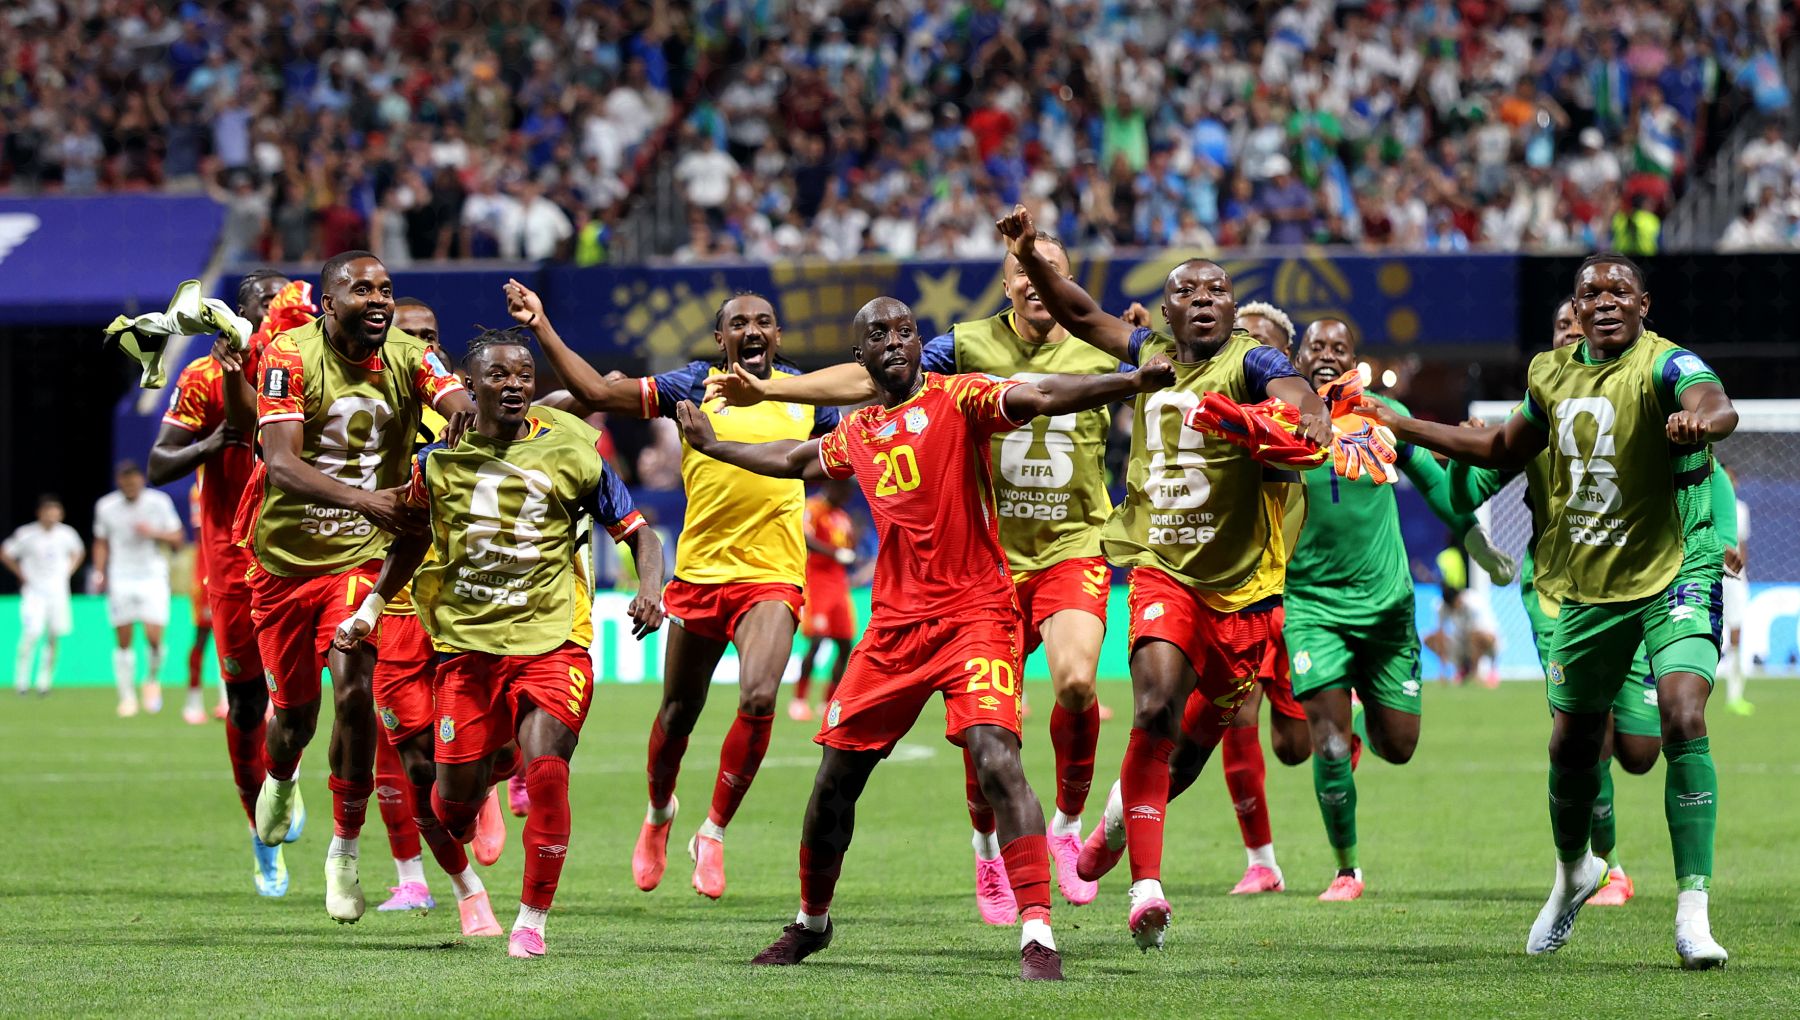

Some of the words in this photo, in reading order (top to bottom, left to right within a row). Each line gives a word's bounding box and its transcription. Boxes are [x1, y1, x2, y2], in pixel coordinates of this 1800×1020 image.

[873, 445, 921, 498] 20
[1021, 465, 1053, 478] FIFA
[1000, 489, 1044, 502] WORLD
[1046, 492, 1071, 503] CUP
[1160, 484, 1192, 498] FIFA
[1576, 489, 1606, 504] FIFA
[305, 504, 353, 519] WORLD
[1000, 501, 1068, 520] 2026
[1150, 513, 1185, 525] WORLD
[1187, 512, 1214, 524] CUP
[301, 517, 371, 536] 2026
[1566, 514, 1601, 528] WORLD
[1603, 518, 1627, 529] CUP
[1148, 526, 1216, 545] 2026
[1569, 527, 1628, 547] 2026
[484, 549, 519, 565] FIFA
[458, 566, 505, 586] WORLD
[506, 577, 532, 589] CUP
[454, 579, 528, 606] 2026
[568, 665, 587, 702] 9
[965, 656, 1015, 696] 20
[1679, 799, 1713, 807] umbro
[1132, 813, 1161, 822] umbro
